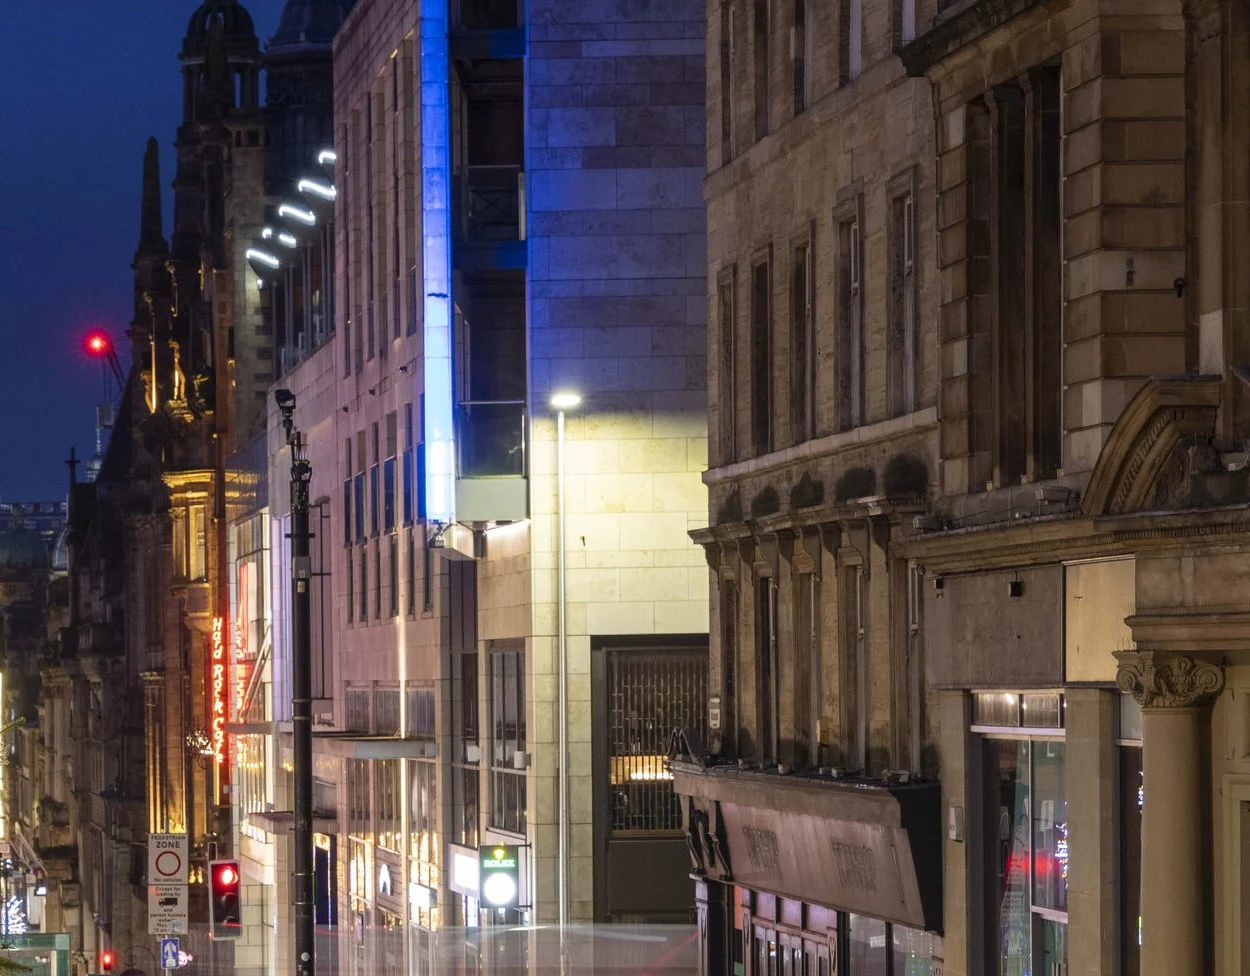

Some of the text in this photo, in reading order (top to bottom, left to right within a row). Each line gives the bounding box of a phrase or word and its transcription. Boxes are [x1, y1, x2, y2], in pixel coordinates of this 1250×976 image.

[212, 616, 224, 659] Hard
[213, 664, 224, 714] Rock
[484, 859, 516, 868] ROLEX
